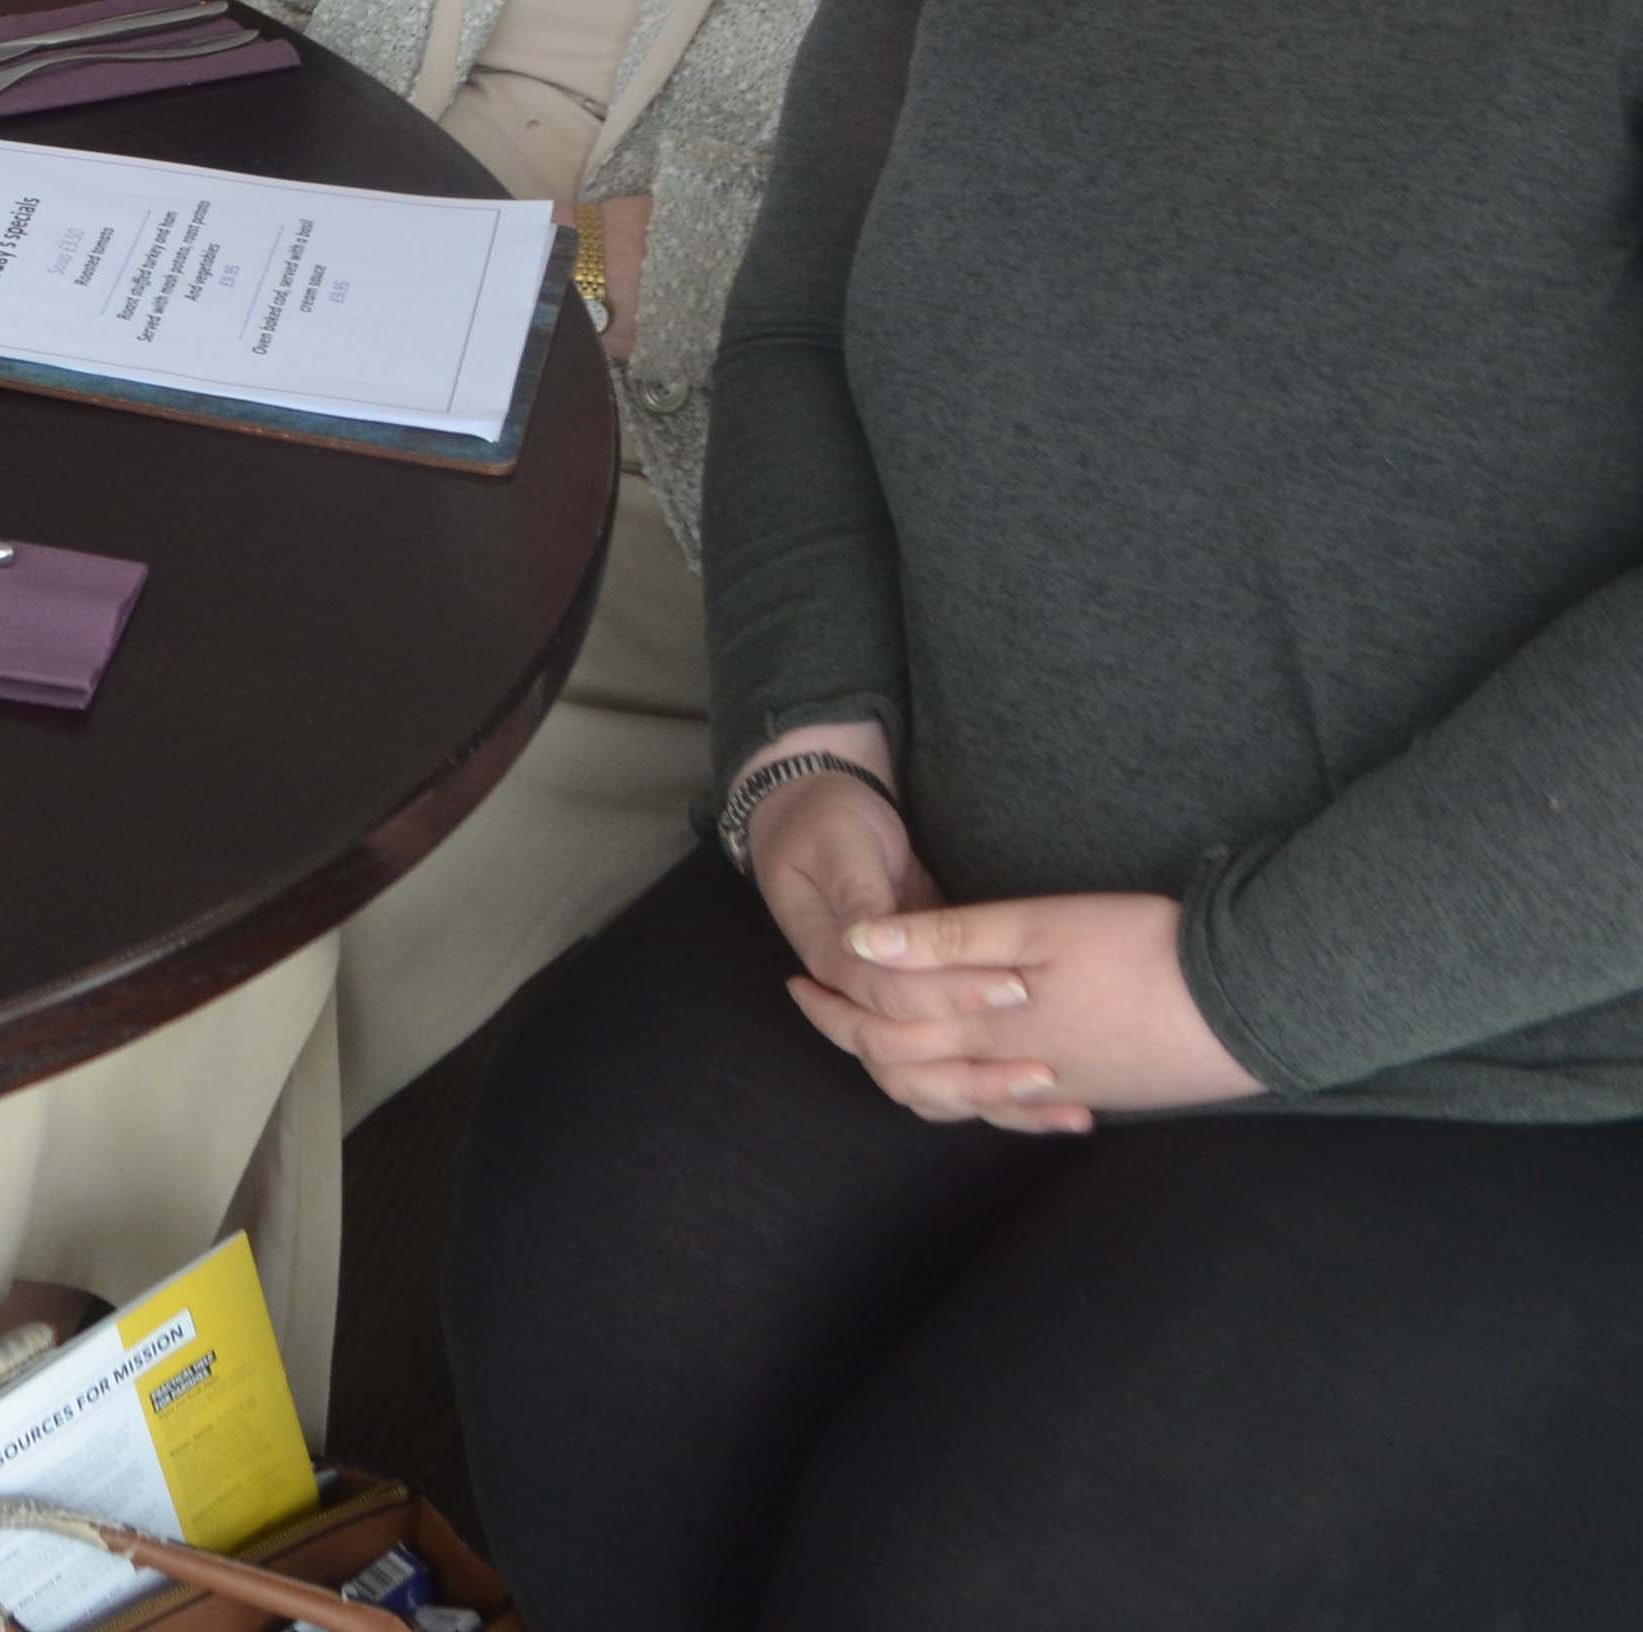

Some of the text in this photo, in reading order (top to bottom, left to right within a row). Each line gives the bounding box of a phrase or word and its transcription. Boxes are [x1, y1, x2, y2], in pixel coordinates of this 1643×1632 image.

[4, 196, 40, 241] specials
[295, 218, 314, 238] basil
[74, 227, 114, 286] Roasted tomato
[117, 210, 178, 321] Roast stuffed turkey and ham
[137, 314, 161, 343] Served
[152, 295, 168, 315] with
[161, 274, 179, 296] mash
[183, 223, 200, 244] roast
[192, 200, 211, 226] potato
[184, 243, 221, 303] And vegetables
[280, 261, 299, 288] served
[289, 244, 305, 262] with
[300, 264, 327, 313] cream sauce
[260, 305, 282, 333] baked
[252, 333, 273, 355] Oven
[77, 1380, 111, 1411] FOR
[113, 1323, 184, 1385] MISSION
